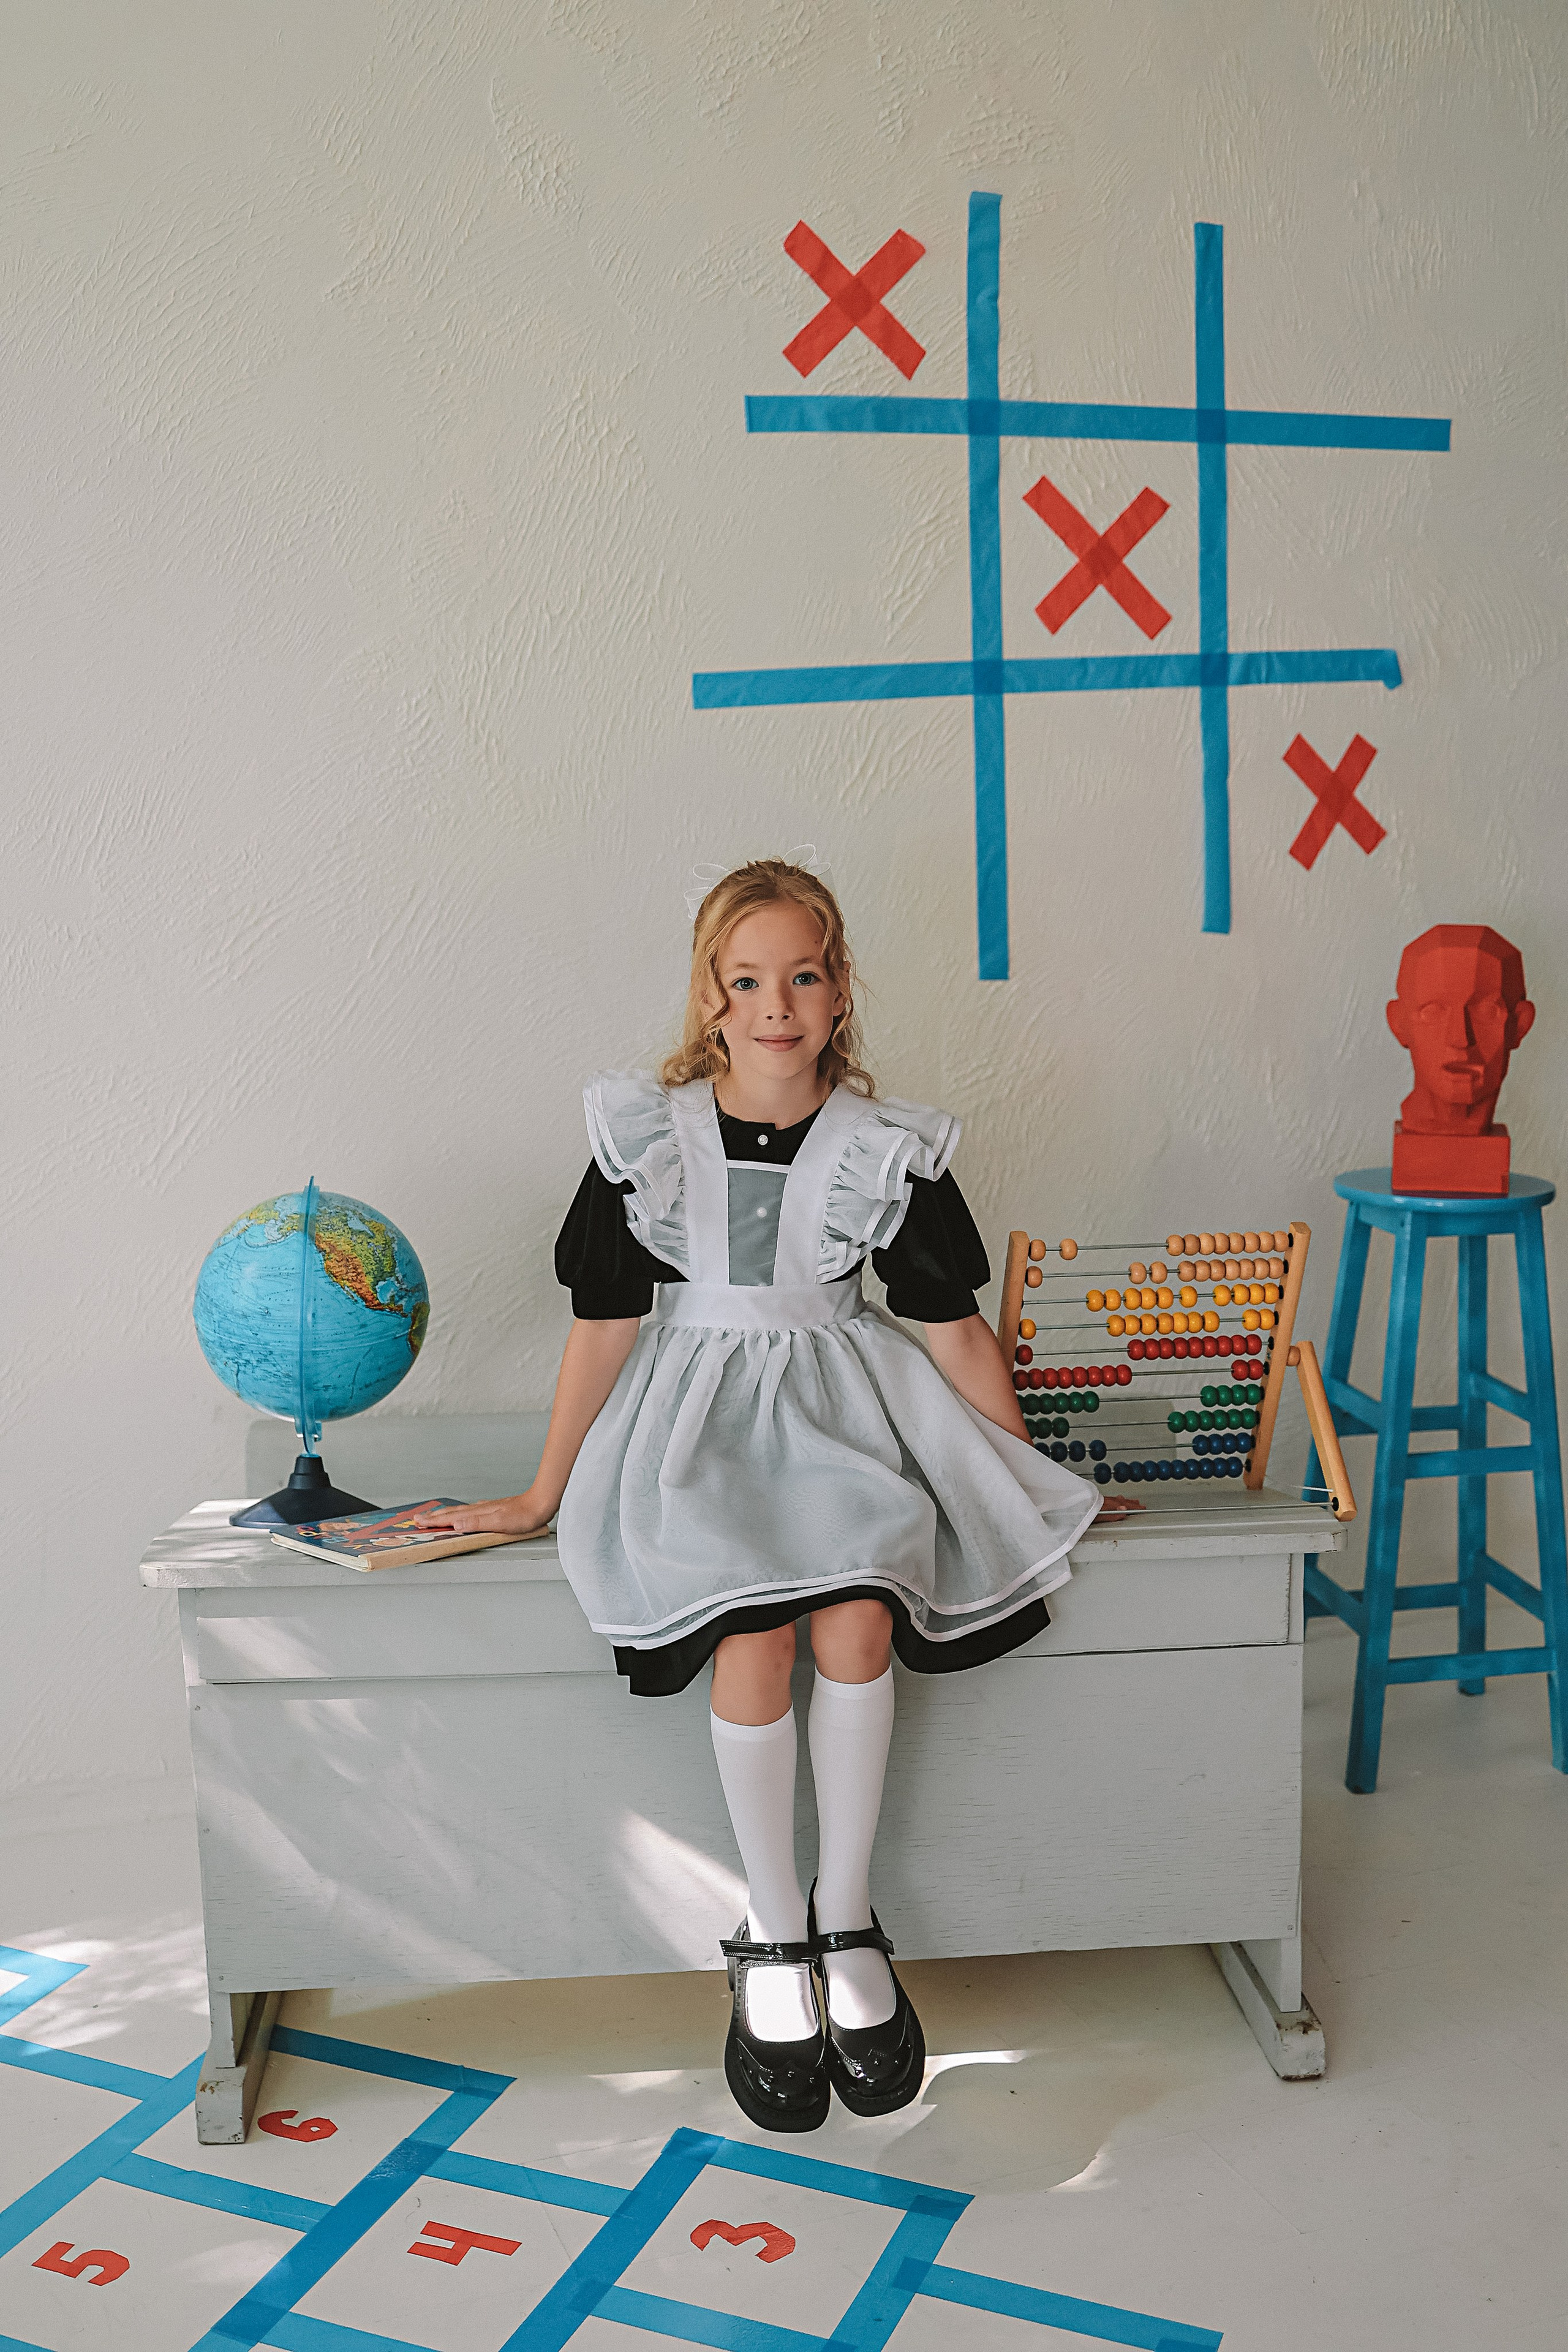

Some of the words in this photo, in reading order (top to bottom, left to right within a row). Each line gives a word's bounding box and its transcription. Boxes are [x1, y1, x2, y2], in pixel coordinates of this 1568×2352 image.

[296, 1525, 387, 1553] УВАРЬ
[257, 2109, 339, 2143] 6
[31, 2241, 130, 2286] 5
[407, 2220, 522, 2267] 4
[690, 2218, 796, 2264] 3
